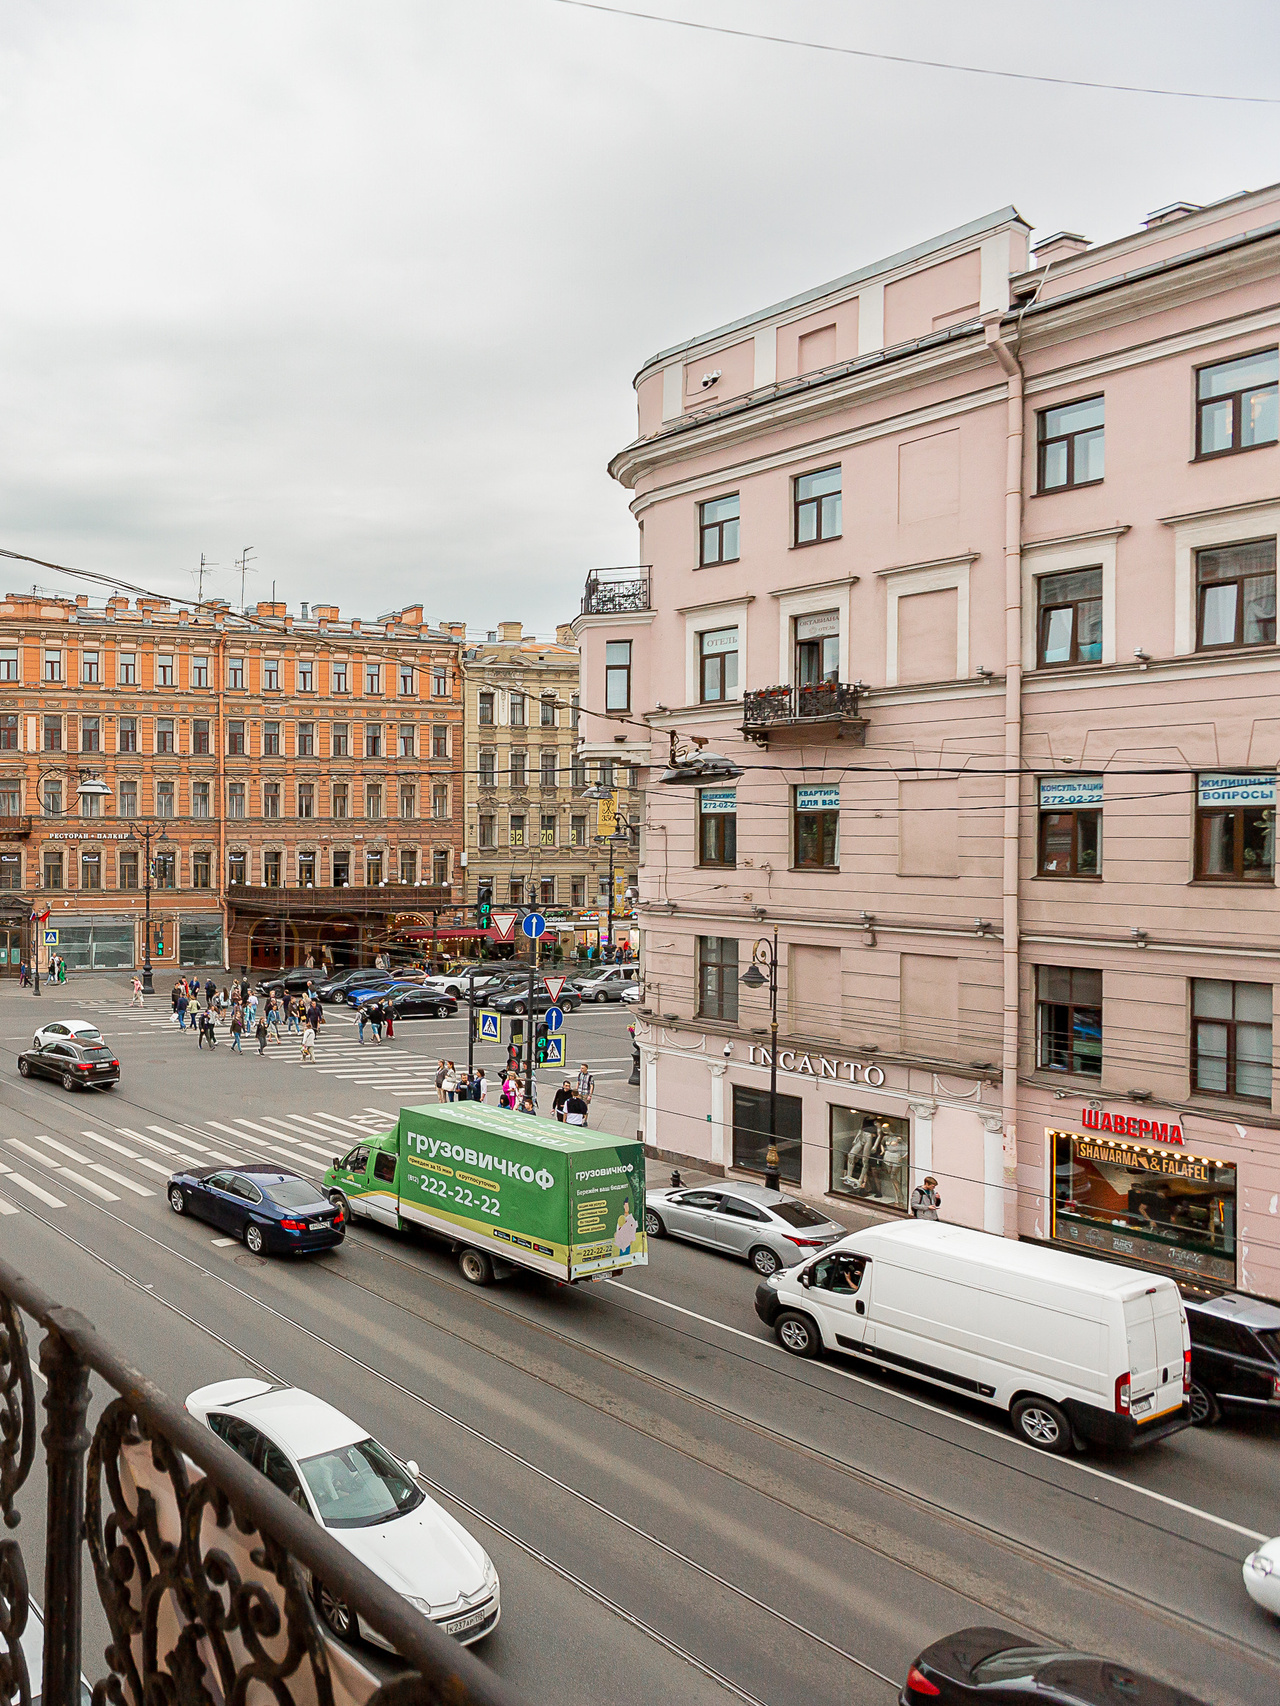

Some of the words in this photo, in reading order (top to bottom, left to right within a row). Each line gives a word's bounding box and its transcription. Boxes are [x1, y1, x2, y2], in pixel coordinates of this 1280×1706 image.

[707, 636, 738, 648] ОТЕЛЬ
[1201, 777, 1277, 788] ЖИЛИЩНЫЕ
[1043, 795, 1103, 804] 272-02-22
[1202, 790, 1274, 800] ВОПРОСЫ
[747, 1046, 885, 1087] INCANTO
[1082, 1108, 1185, 1145] ШАВЕРМА
[1080, 1143, 1139, 1167] SHAWARMA
[1150, 1157, 1161, 1171] &
[1162, 1160, 1208, 1180] FALAFEL
[420, 1175, 501, 1217] 222-22-22
